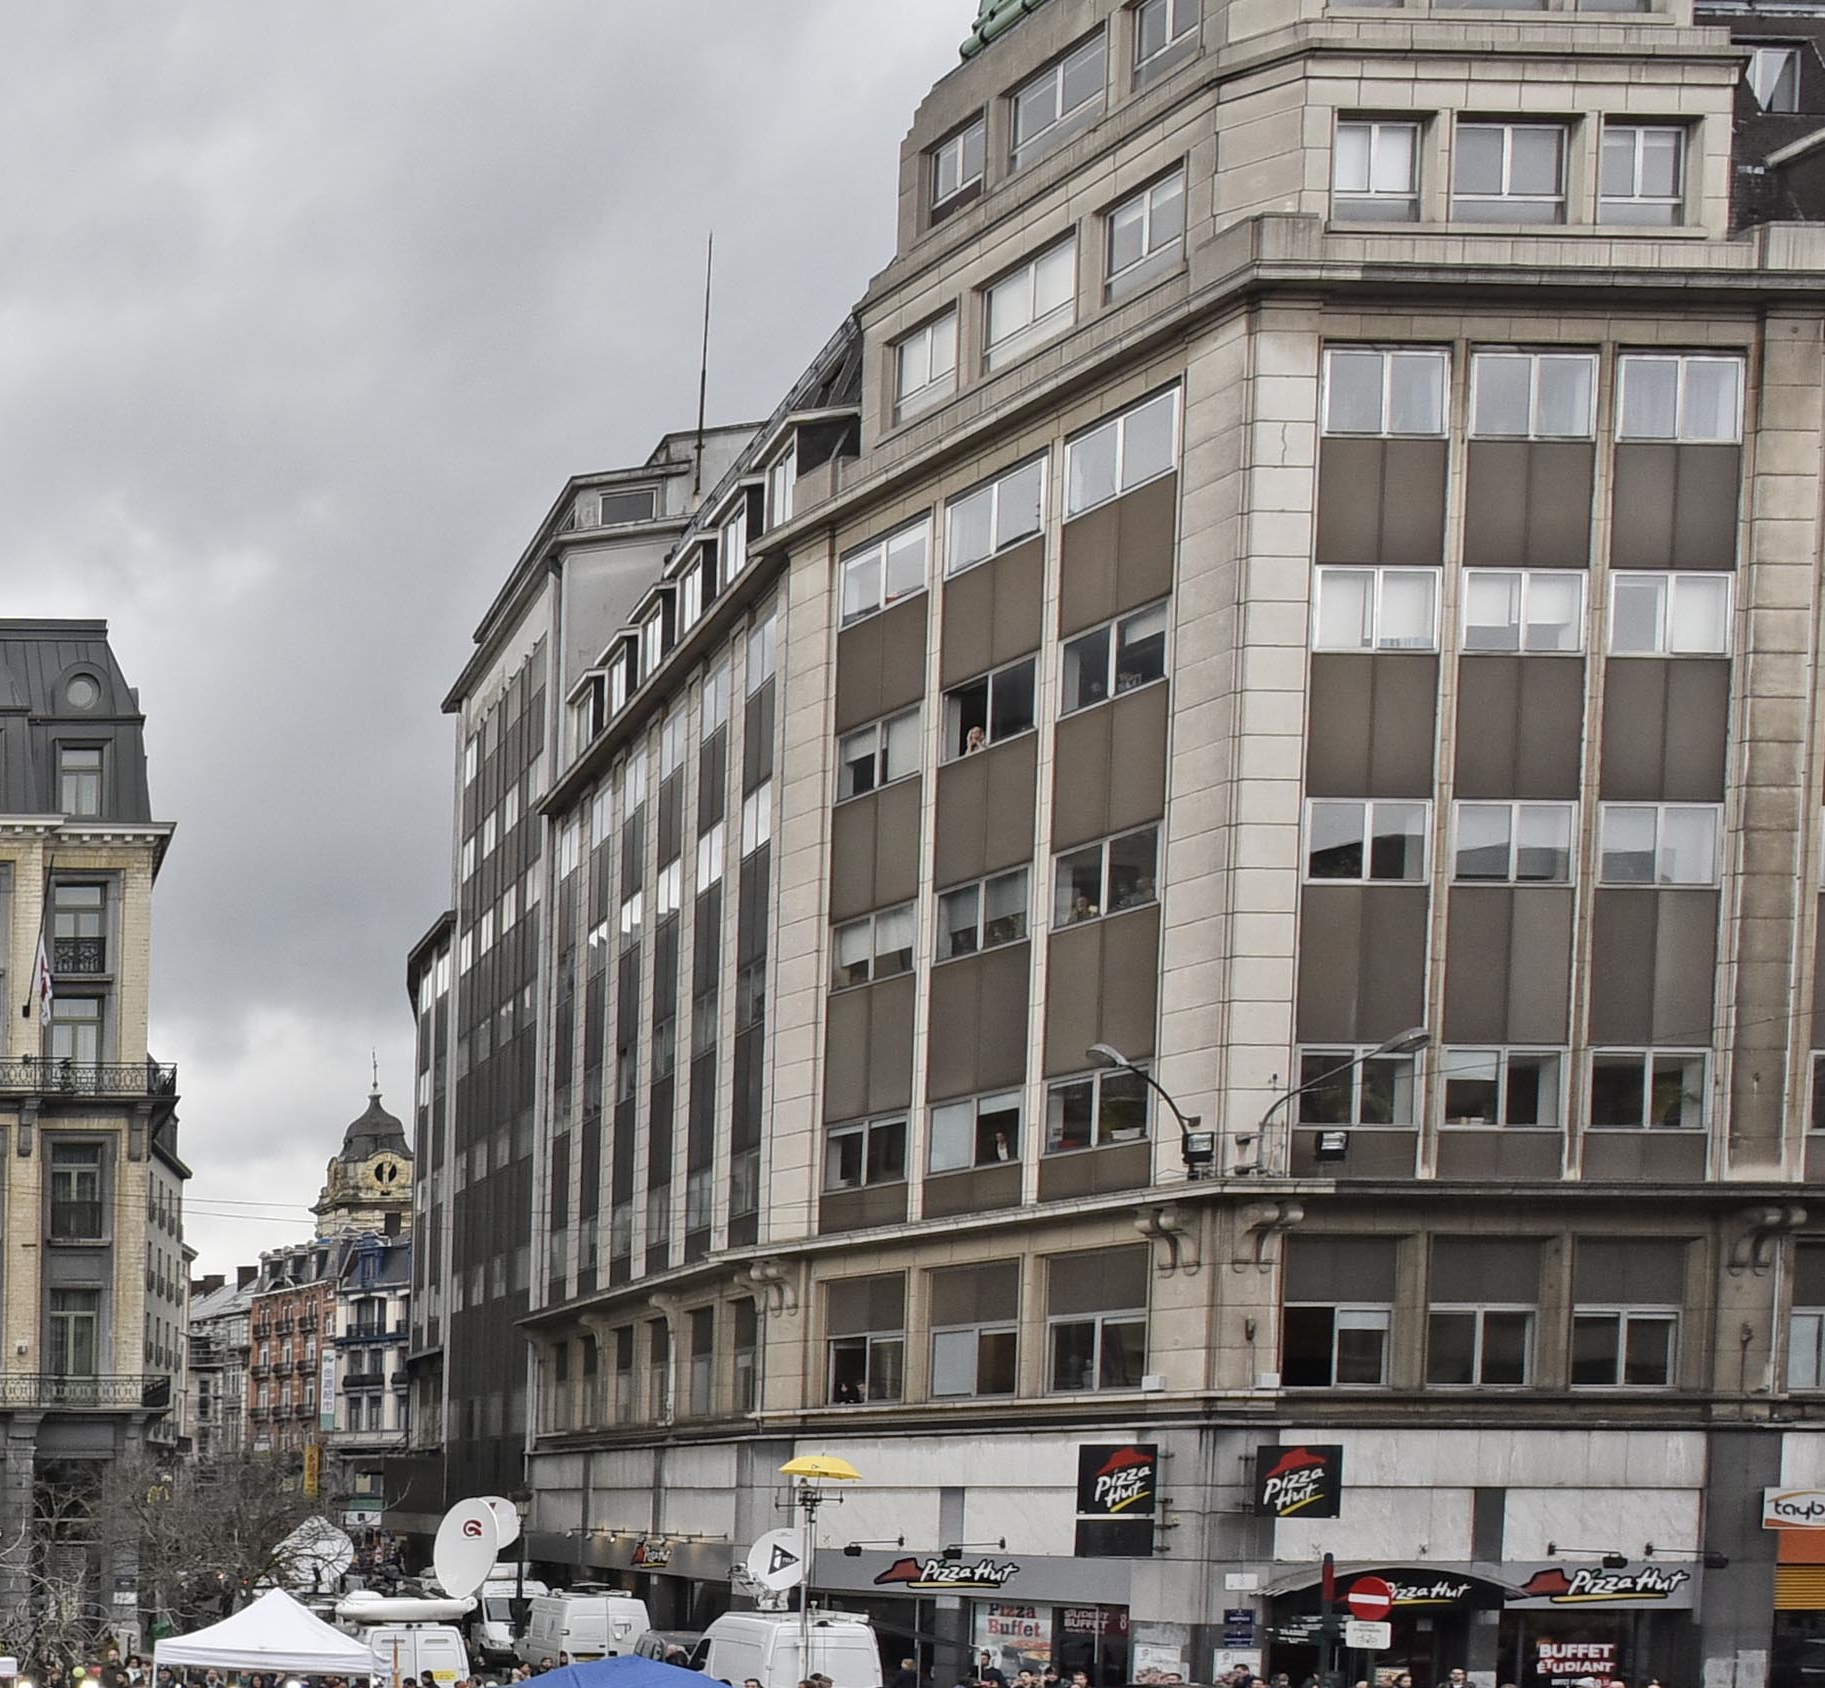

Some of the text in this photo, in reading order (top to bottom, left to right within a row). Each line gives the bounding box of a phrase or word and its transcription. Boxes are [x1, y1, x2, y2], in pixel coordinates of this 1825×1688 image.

[1095, 1465, 1152, 1502] Pizza
[1105, 1481, 1146, 1508] Hut
[1263, 1467, 1325, 1505] Pizza
[1275, 1483, 1319, 1511] Hut
[920, 1559, 1019, 1582] Pizza Hut
[1567, 1568, 1690, 1595] Pizza Hut
[1429, 1581, 1473, 1598] Hut
[988, 1602, 1036, 1619] Pizza
[988, 1619, 1041, 1638] Buffet
[1539, 1644, 1615, 1659] BUFFET
[1536, 1659, 1616, 1675] ÉTUDIANT
